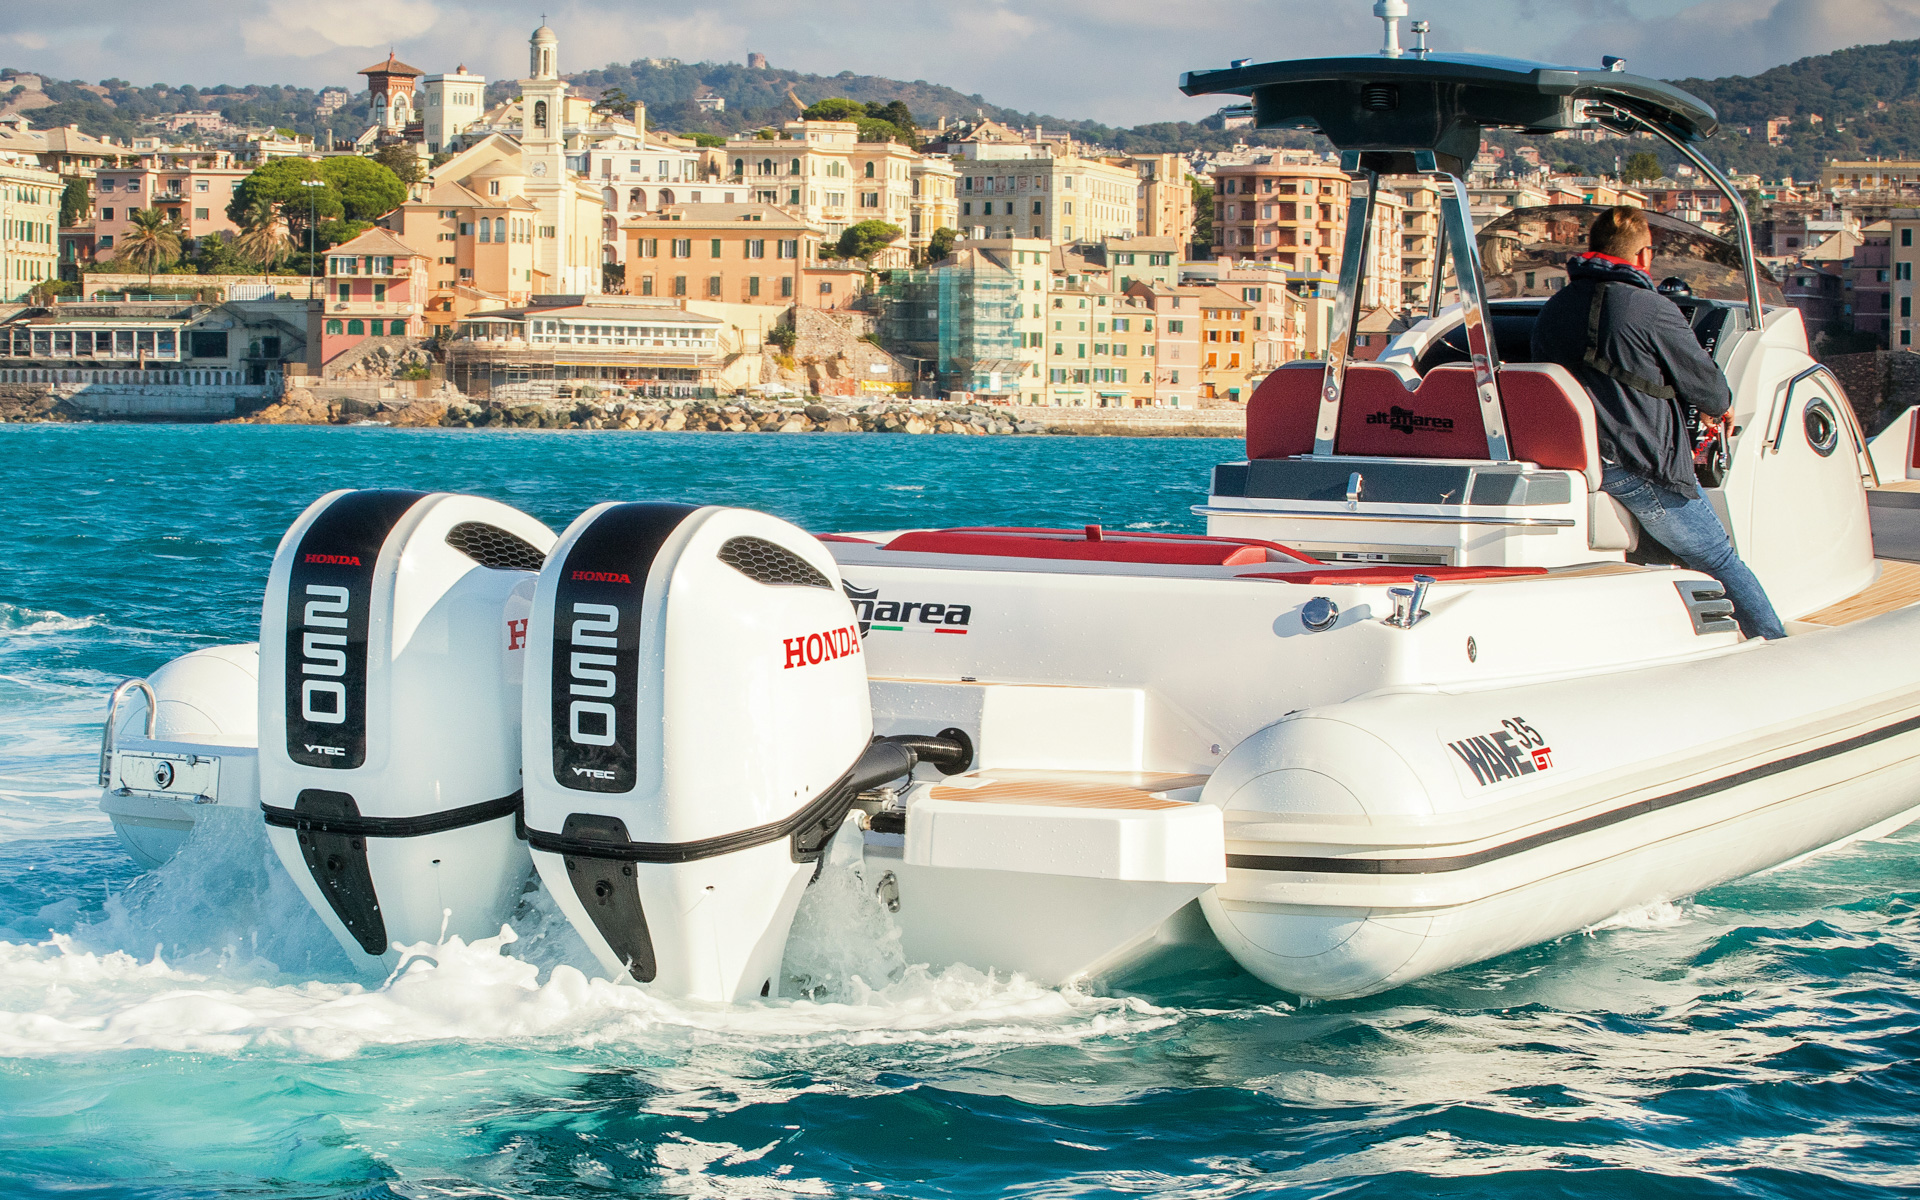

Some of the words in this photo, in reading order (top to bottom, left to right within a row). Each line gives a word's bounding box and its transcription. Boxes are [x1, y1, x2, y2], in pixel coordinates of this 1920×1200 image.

[1366, 411, 1454, 429] altamarea
[304, 553, 361, 566] HONDA
[571, 570, 631, 584] HONDA
[849, 600, 971, 626] marea
[302, 584, 350, 724] 250
[782, 624, 860, 670] HONDA
[569, 602, 619, 747] 250
[304, 743, 346, 757] VTEC
[1447, 730, 1536, 786] WAVE
[1501, 716, 1545, 749] 35
[1531, 746, 1552, 771] GT
[571, 767, 616, 780] VTEC
